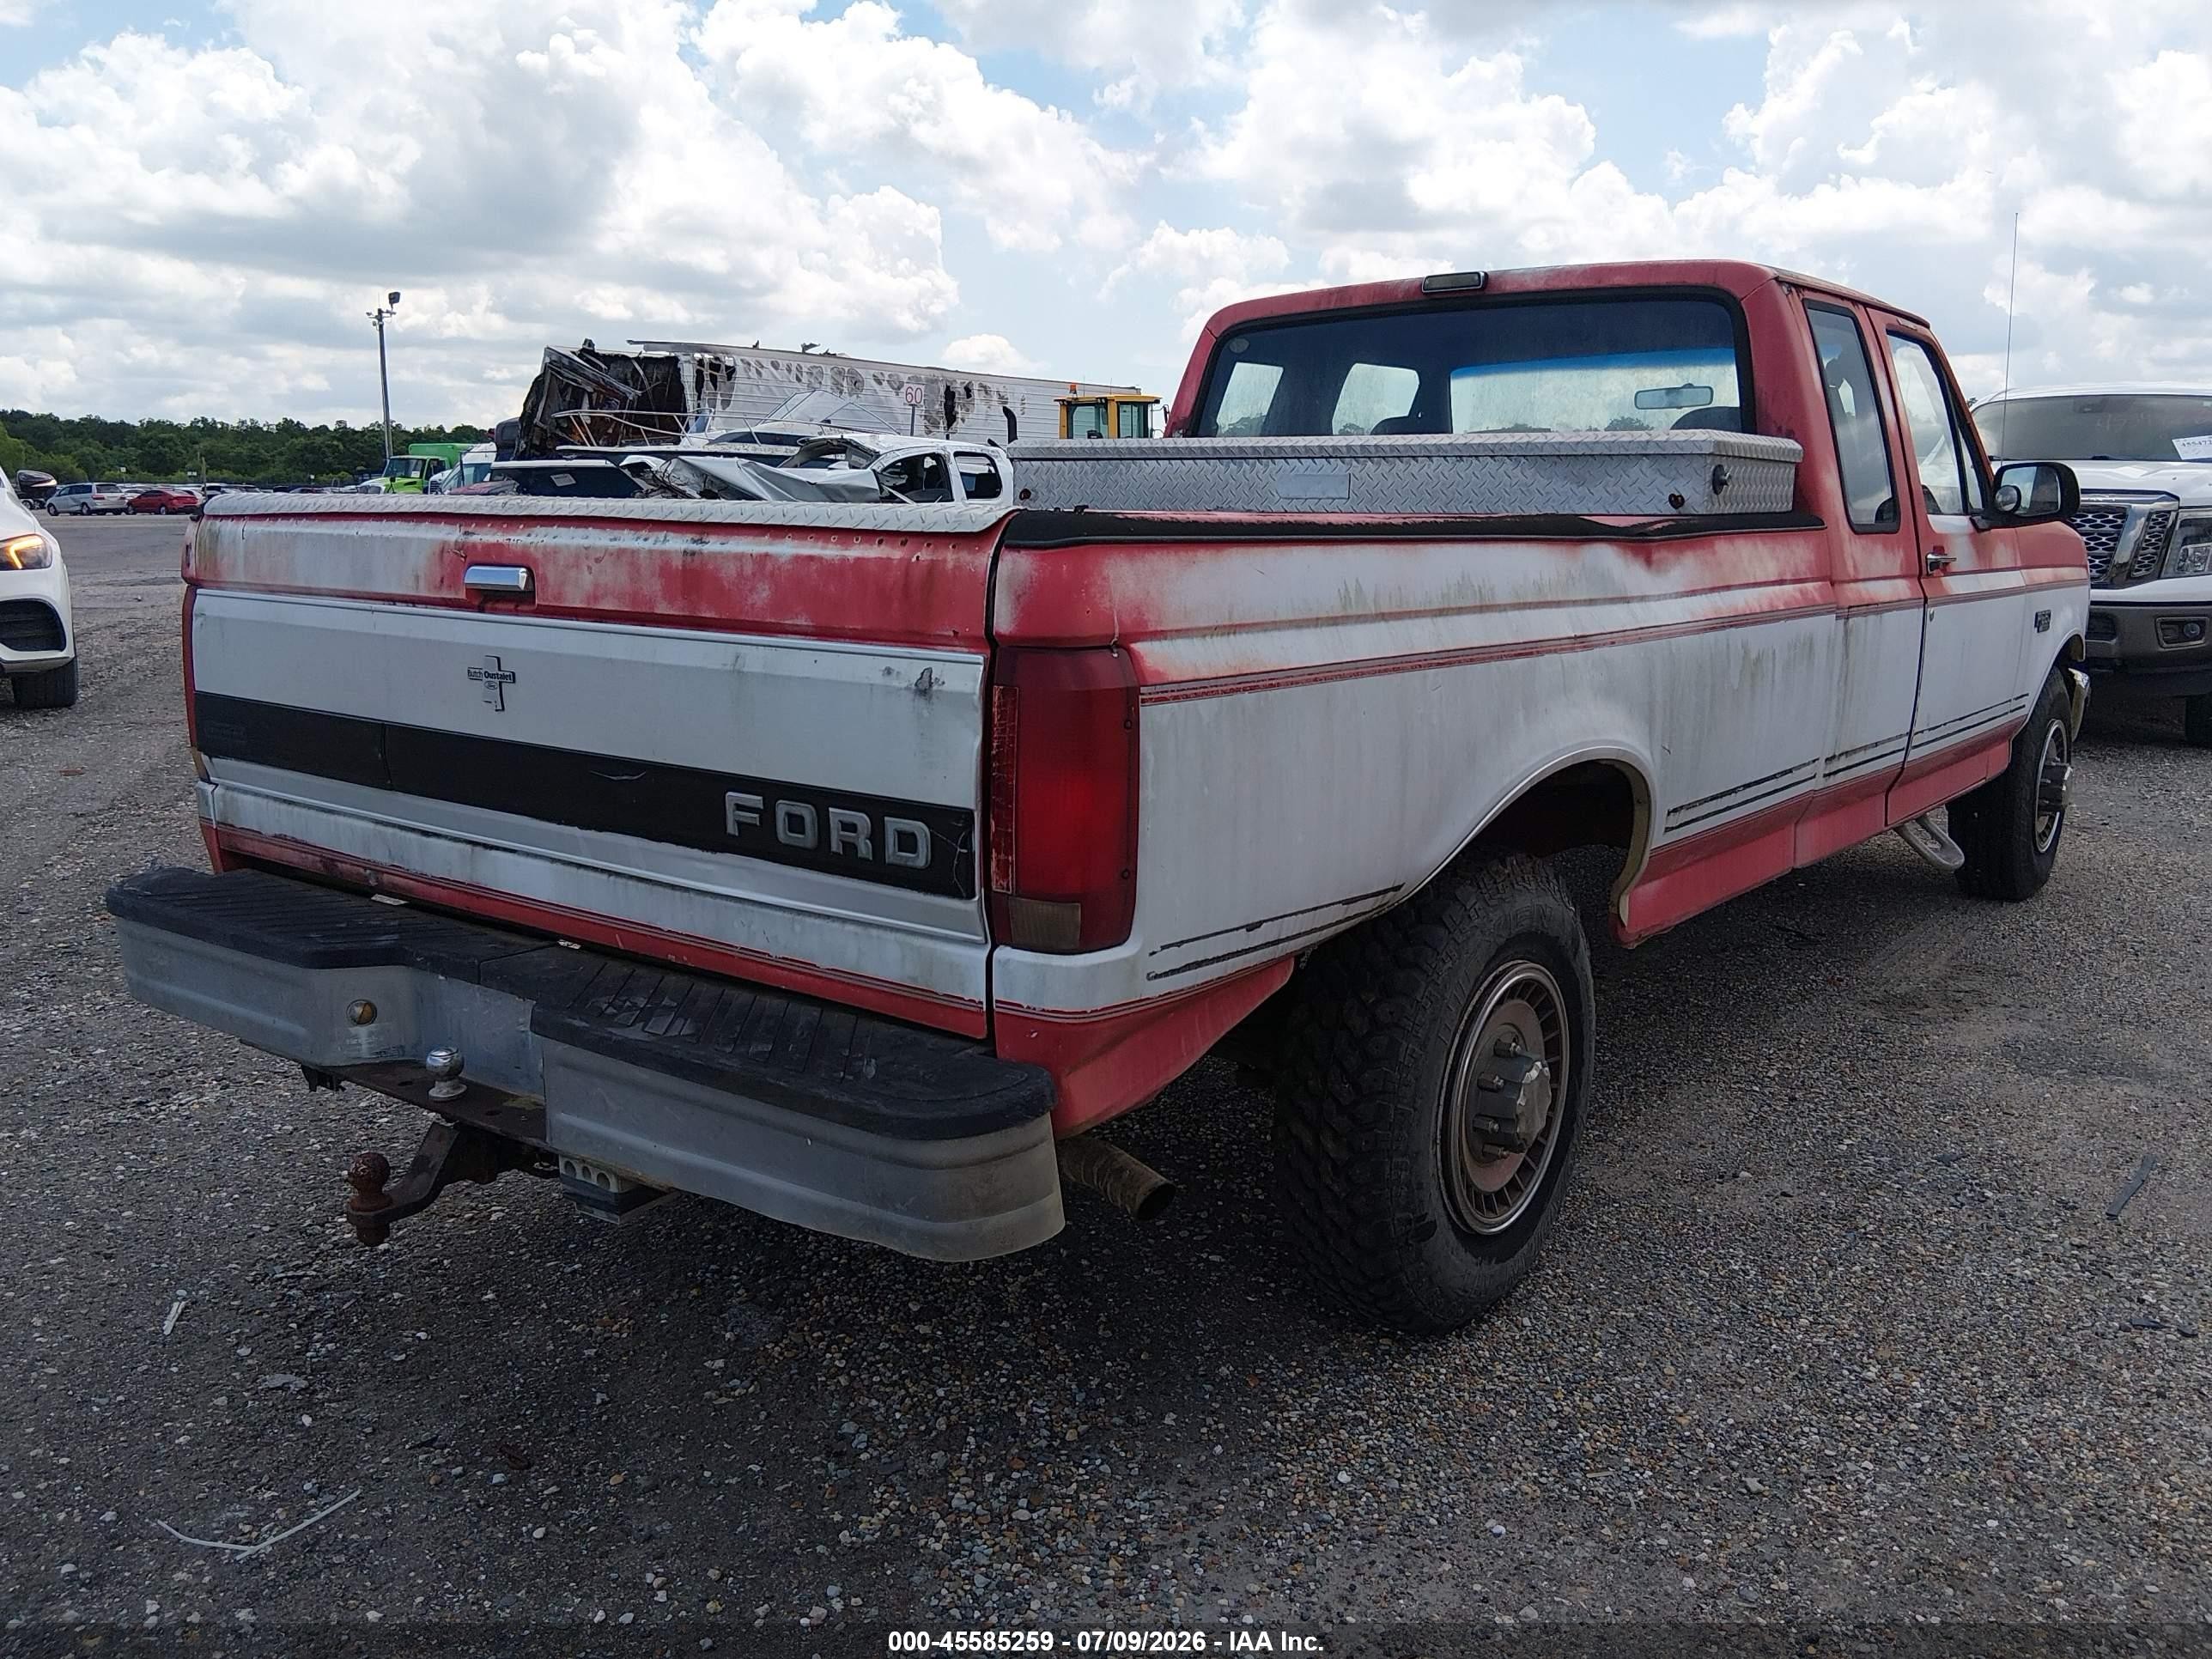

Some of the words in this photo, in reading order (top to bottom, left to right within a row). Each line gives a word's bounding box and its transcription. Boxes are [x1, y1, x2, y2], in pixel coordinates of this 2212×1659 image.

[906, 386, 923, 404] 60
[467, 669, 483, 678] Butch
[725, 790, 933, 870] FORD
